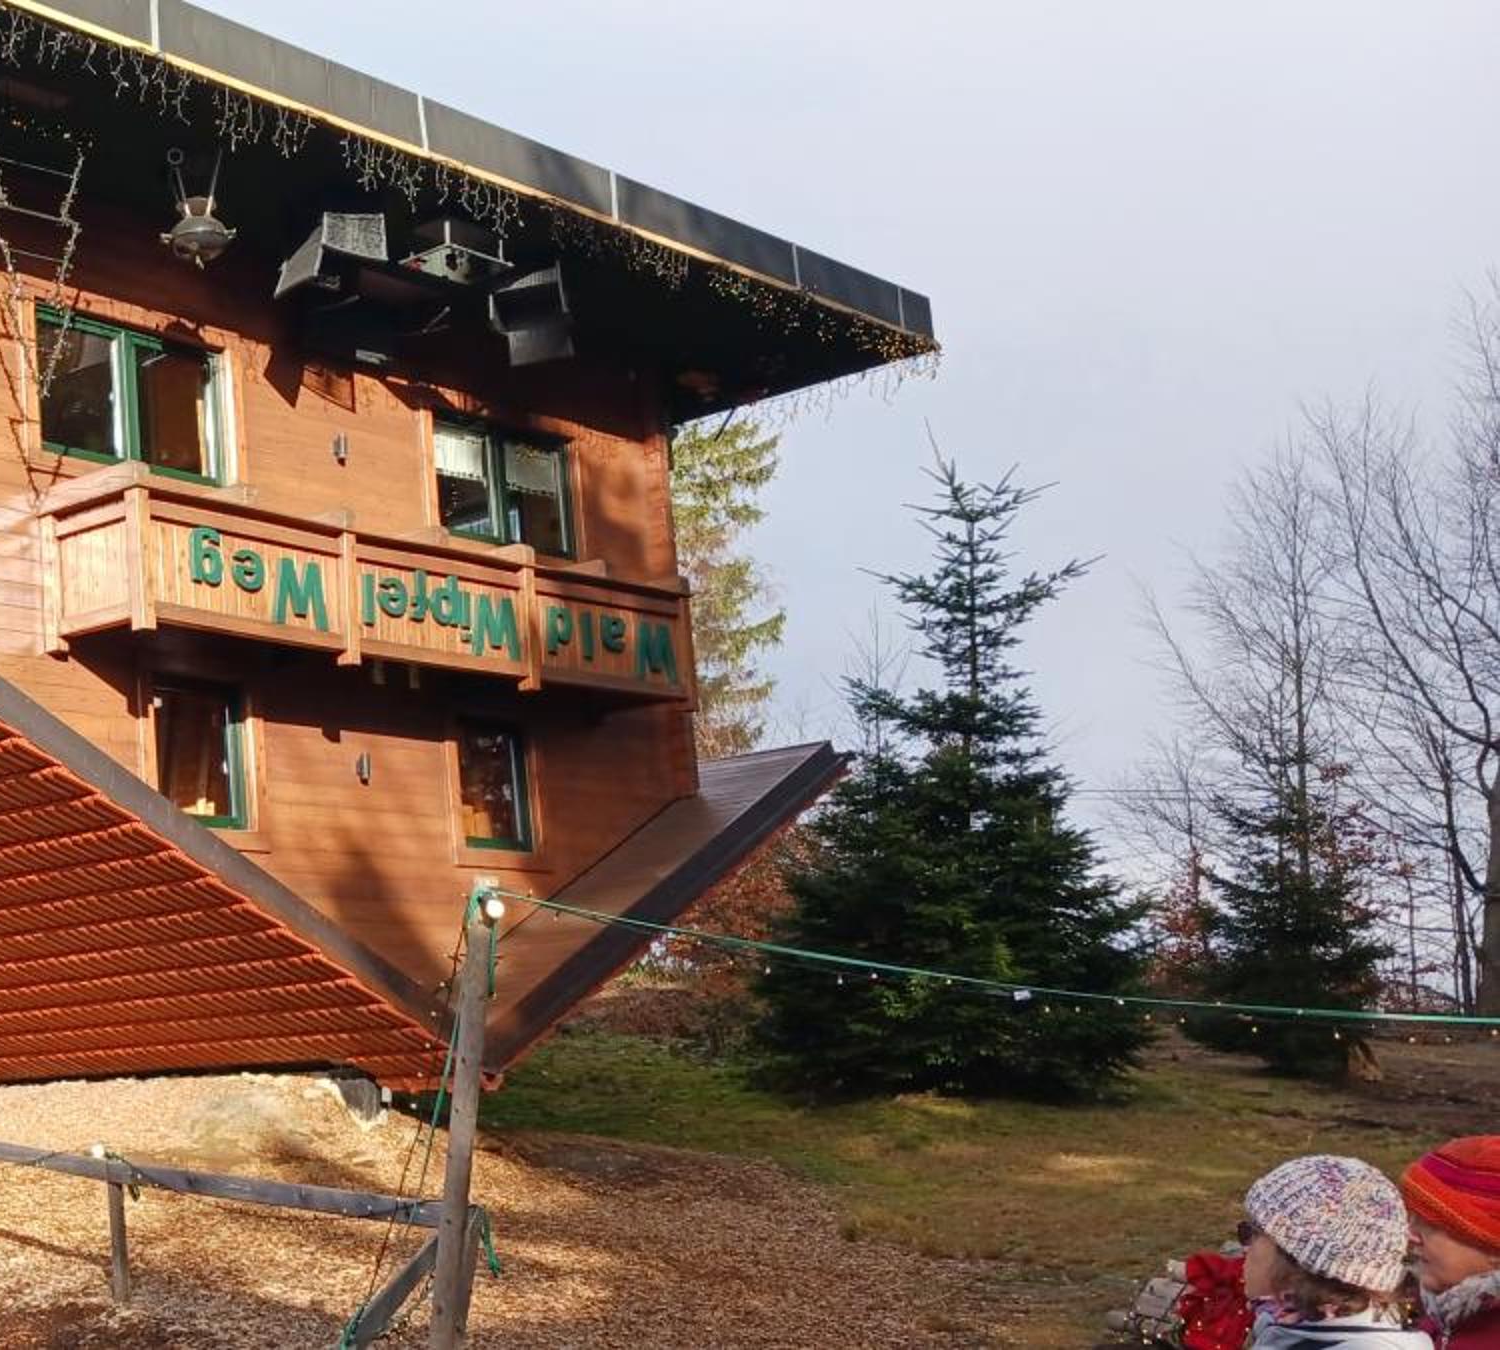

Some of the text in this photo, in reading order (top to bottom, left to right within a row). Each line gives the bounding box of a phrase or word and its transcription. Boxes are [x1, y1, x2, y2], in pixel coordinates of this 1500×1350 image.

[188, 526, 678, 686] Wald Wipfel Weg
